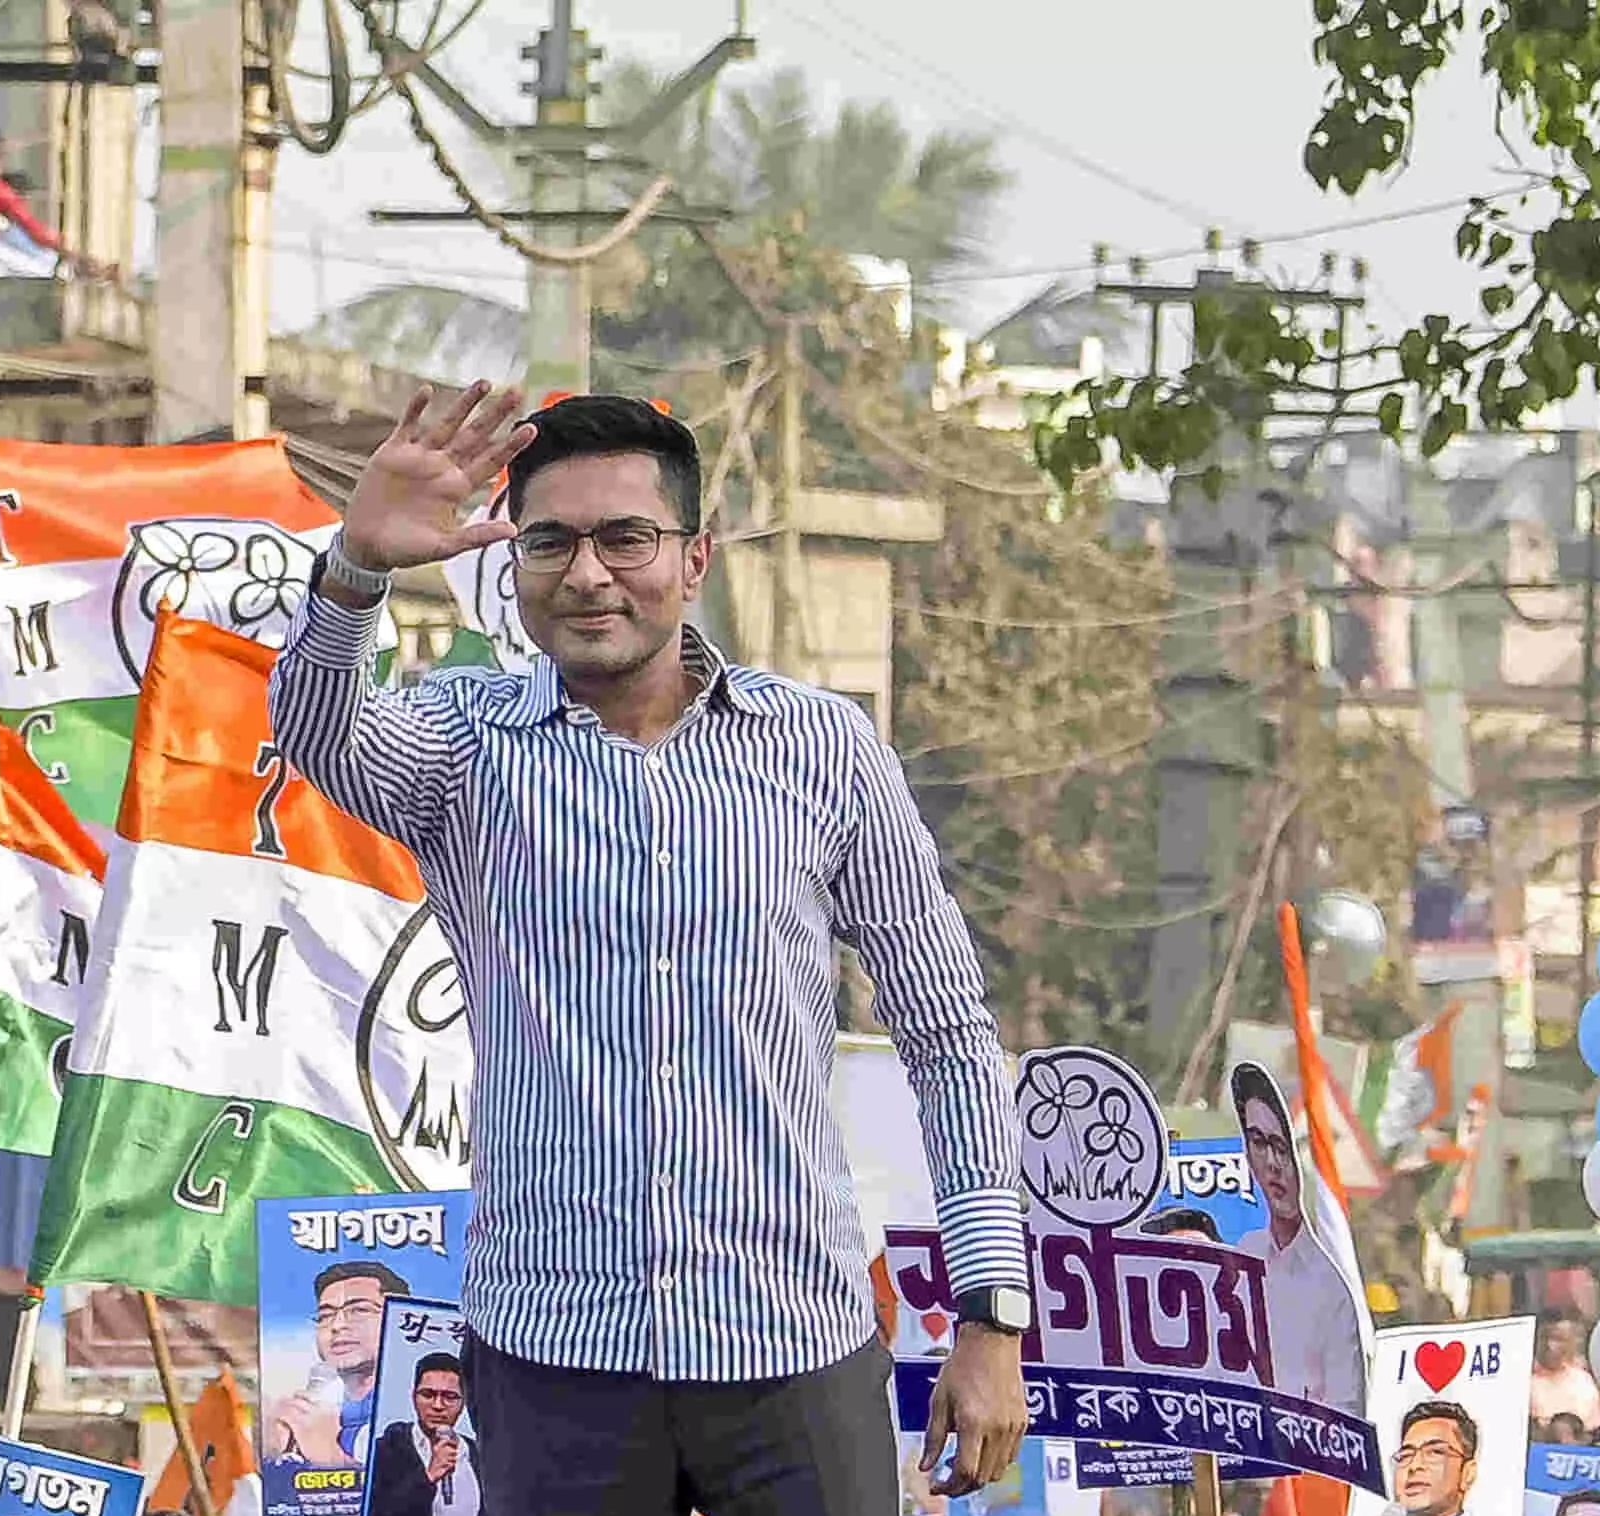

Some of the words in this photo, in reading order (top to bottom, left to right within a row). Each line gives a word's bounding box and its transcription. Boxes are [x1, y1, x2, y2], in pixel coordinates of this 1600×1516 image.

[7, 601, 59, 676] M
[19, 712, 67, 783] C
[211, 919, 287, 1036] M
[174, 1105, 253, 1214] C
[1398, 1349, 1406, 1383] I
[1468, 1342, 1501, 1379] AB
[1065, 1382, 1141, 1429] ব্লক
[1147, 1388, 1264, 1449] তৃণমূল
[1270, 1406, 1367, 1470] কংগ্রেস
